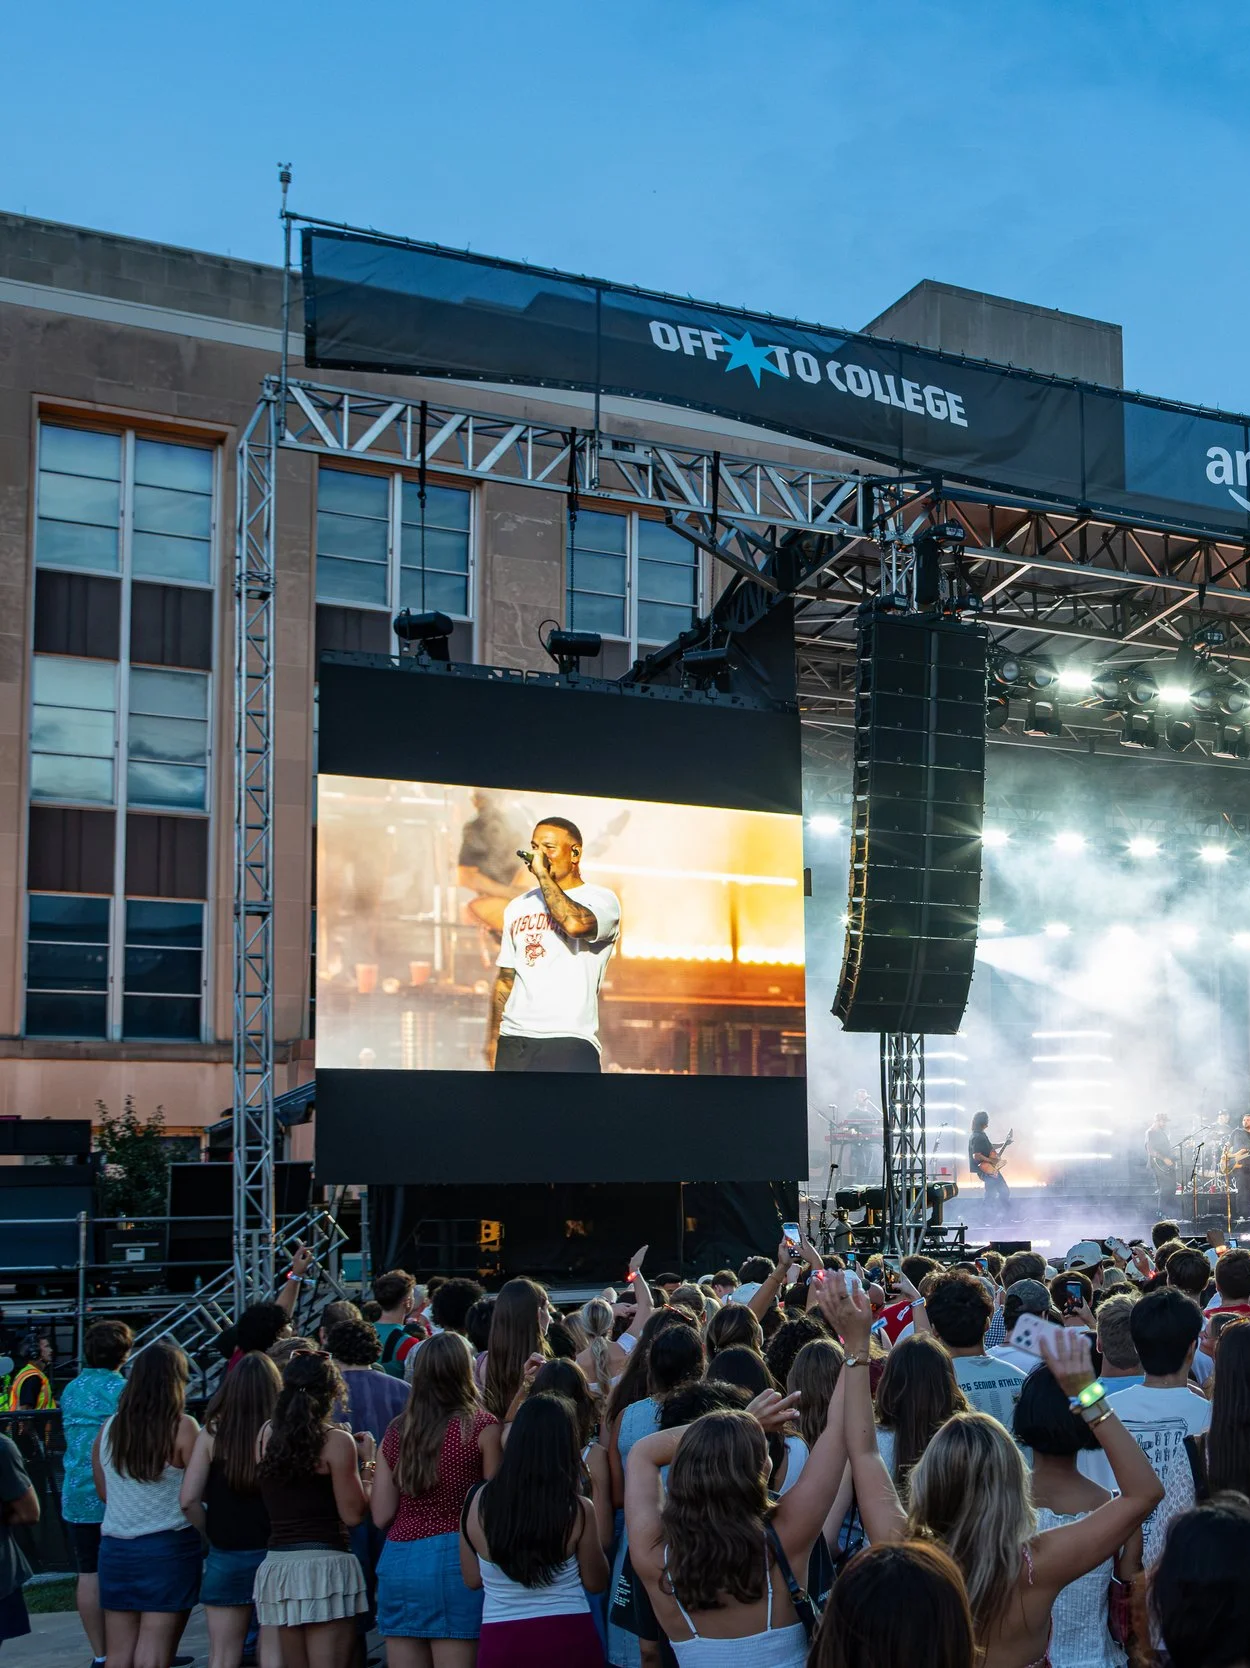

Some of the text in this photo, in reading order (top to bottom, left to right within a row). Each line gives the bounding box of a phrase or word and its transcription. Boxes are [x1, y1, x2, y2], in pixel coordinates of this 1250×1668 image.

[649, 320, 968, 428] OFF TO COLLEGE
[974, 1380, 997, 1390] SENIOR
